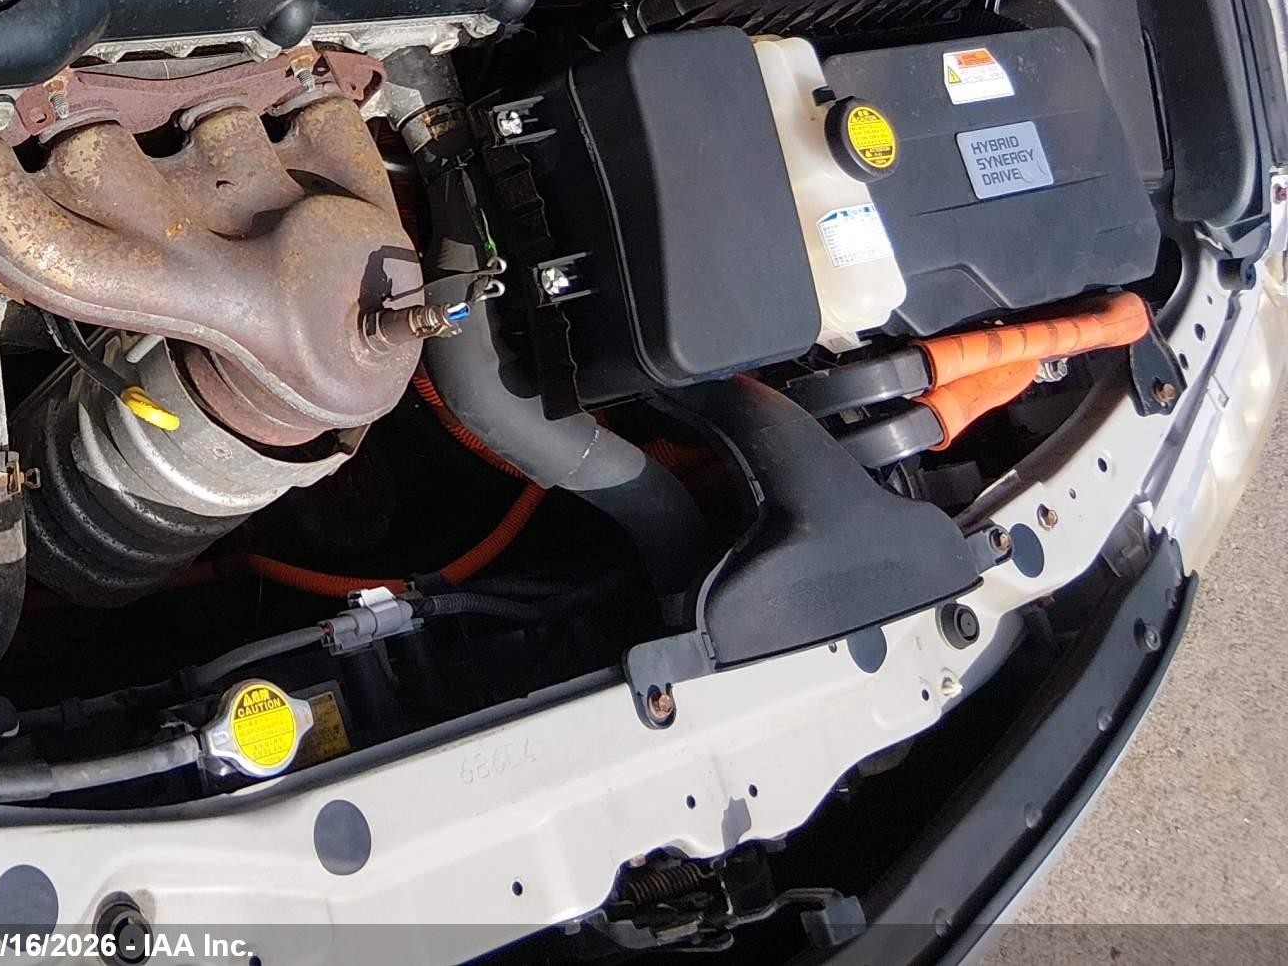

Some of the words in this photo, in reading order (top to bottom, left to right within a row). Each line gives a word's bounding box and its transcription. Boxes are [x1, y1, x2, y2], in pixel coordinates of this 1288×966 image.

[970, 135, 1020, 155] HYBRID
[975, 148, 1034, 171] SYNERGY
[981, 167, 1022, 186] DRIVE
[237, 697, 282, 718] CAUTION
